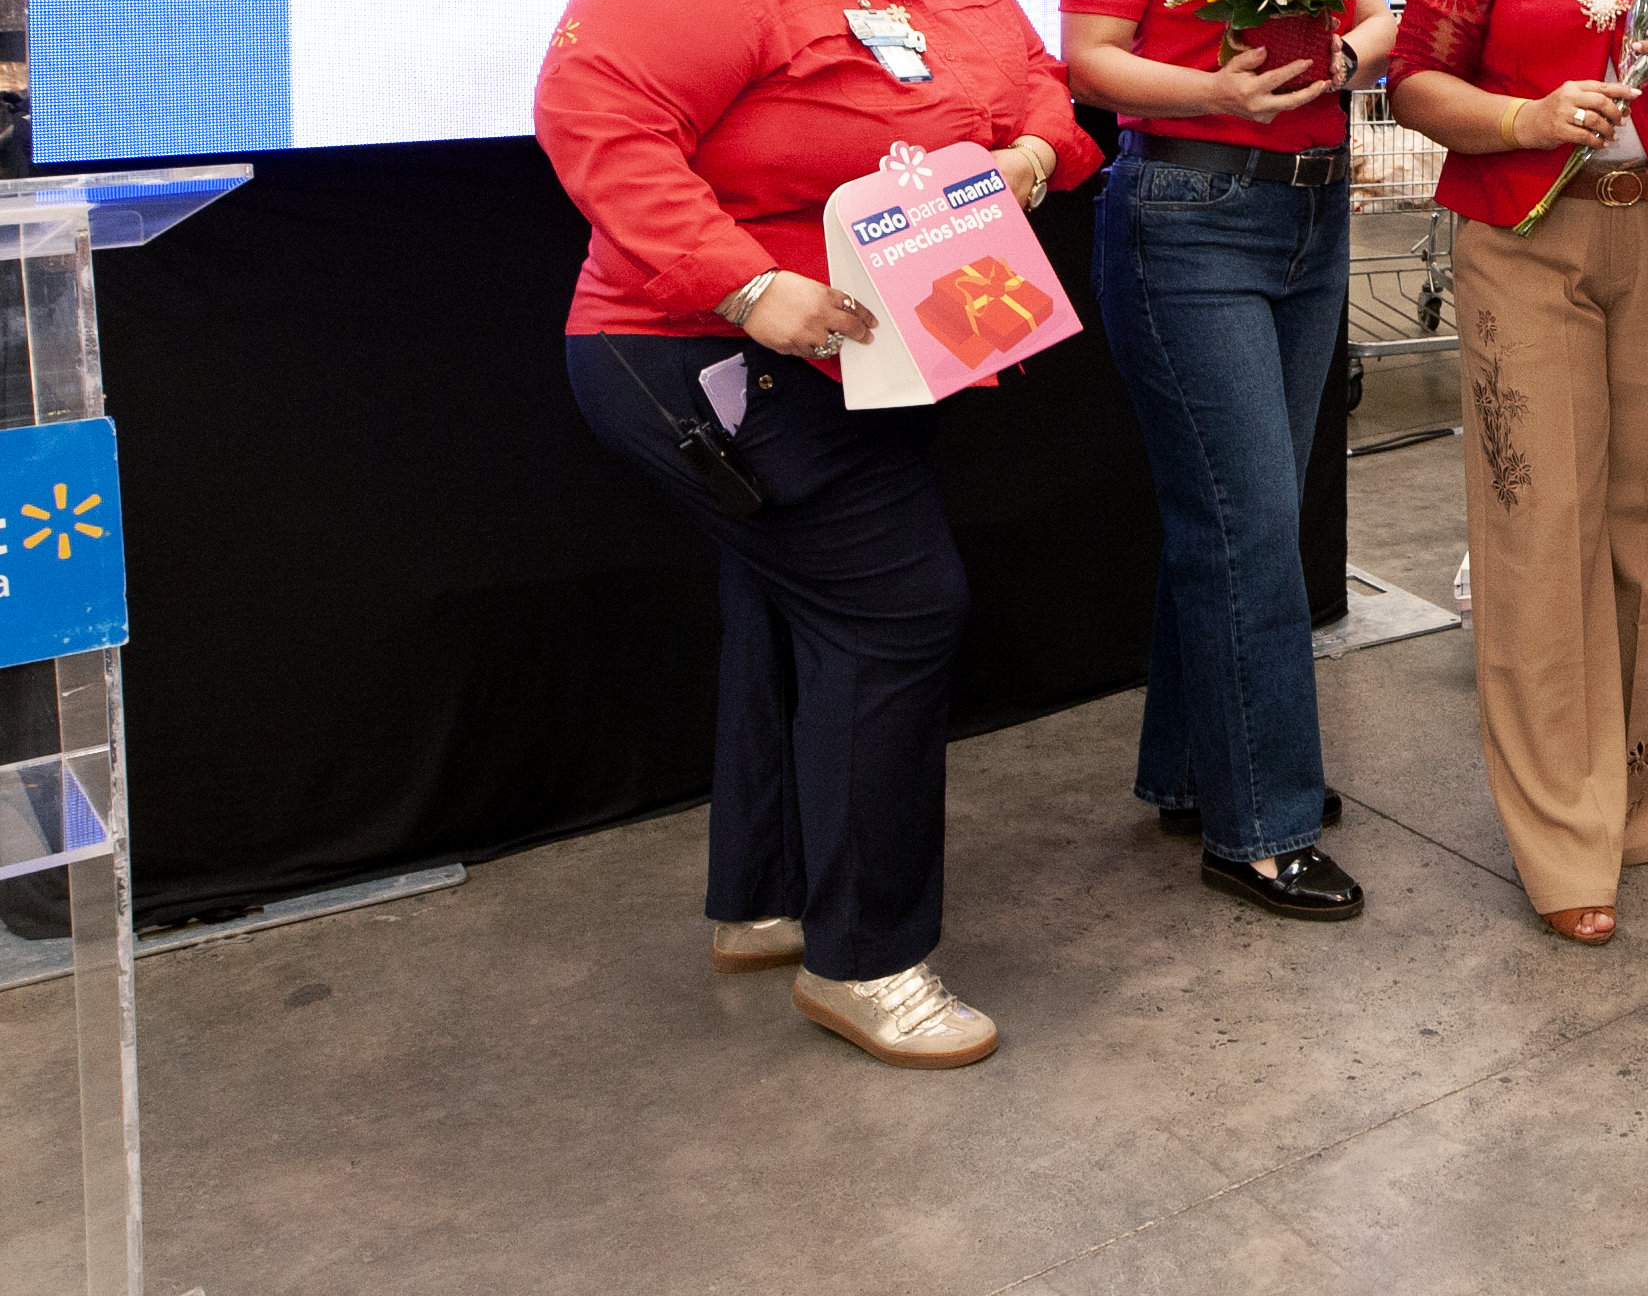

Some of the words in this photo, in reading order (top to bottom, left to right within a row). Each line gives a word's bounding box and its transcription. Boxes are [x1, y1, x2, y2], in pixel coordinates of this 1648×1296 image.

[852, 212, 908, 243] Todo
[906, 196, 949, 227] para
[947, 171, 1005, 208] mamá
[869, 252, 884, 269] a
[882, 223, 954, 267] precios
[950, 203, 1003, 235] bajos
